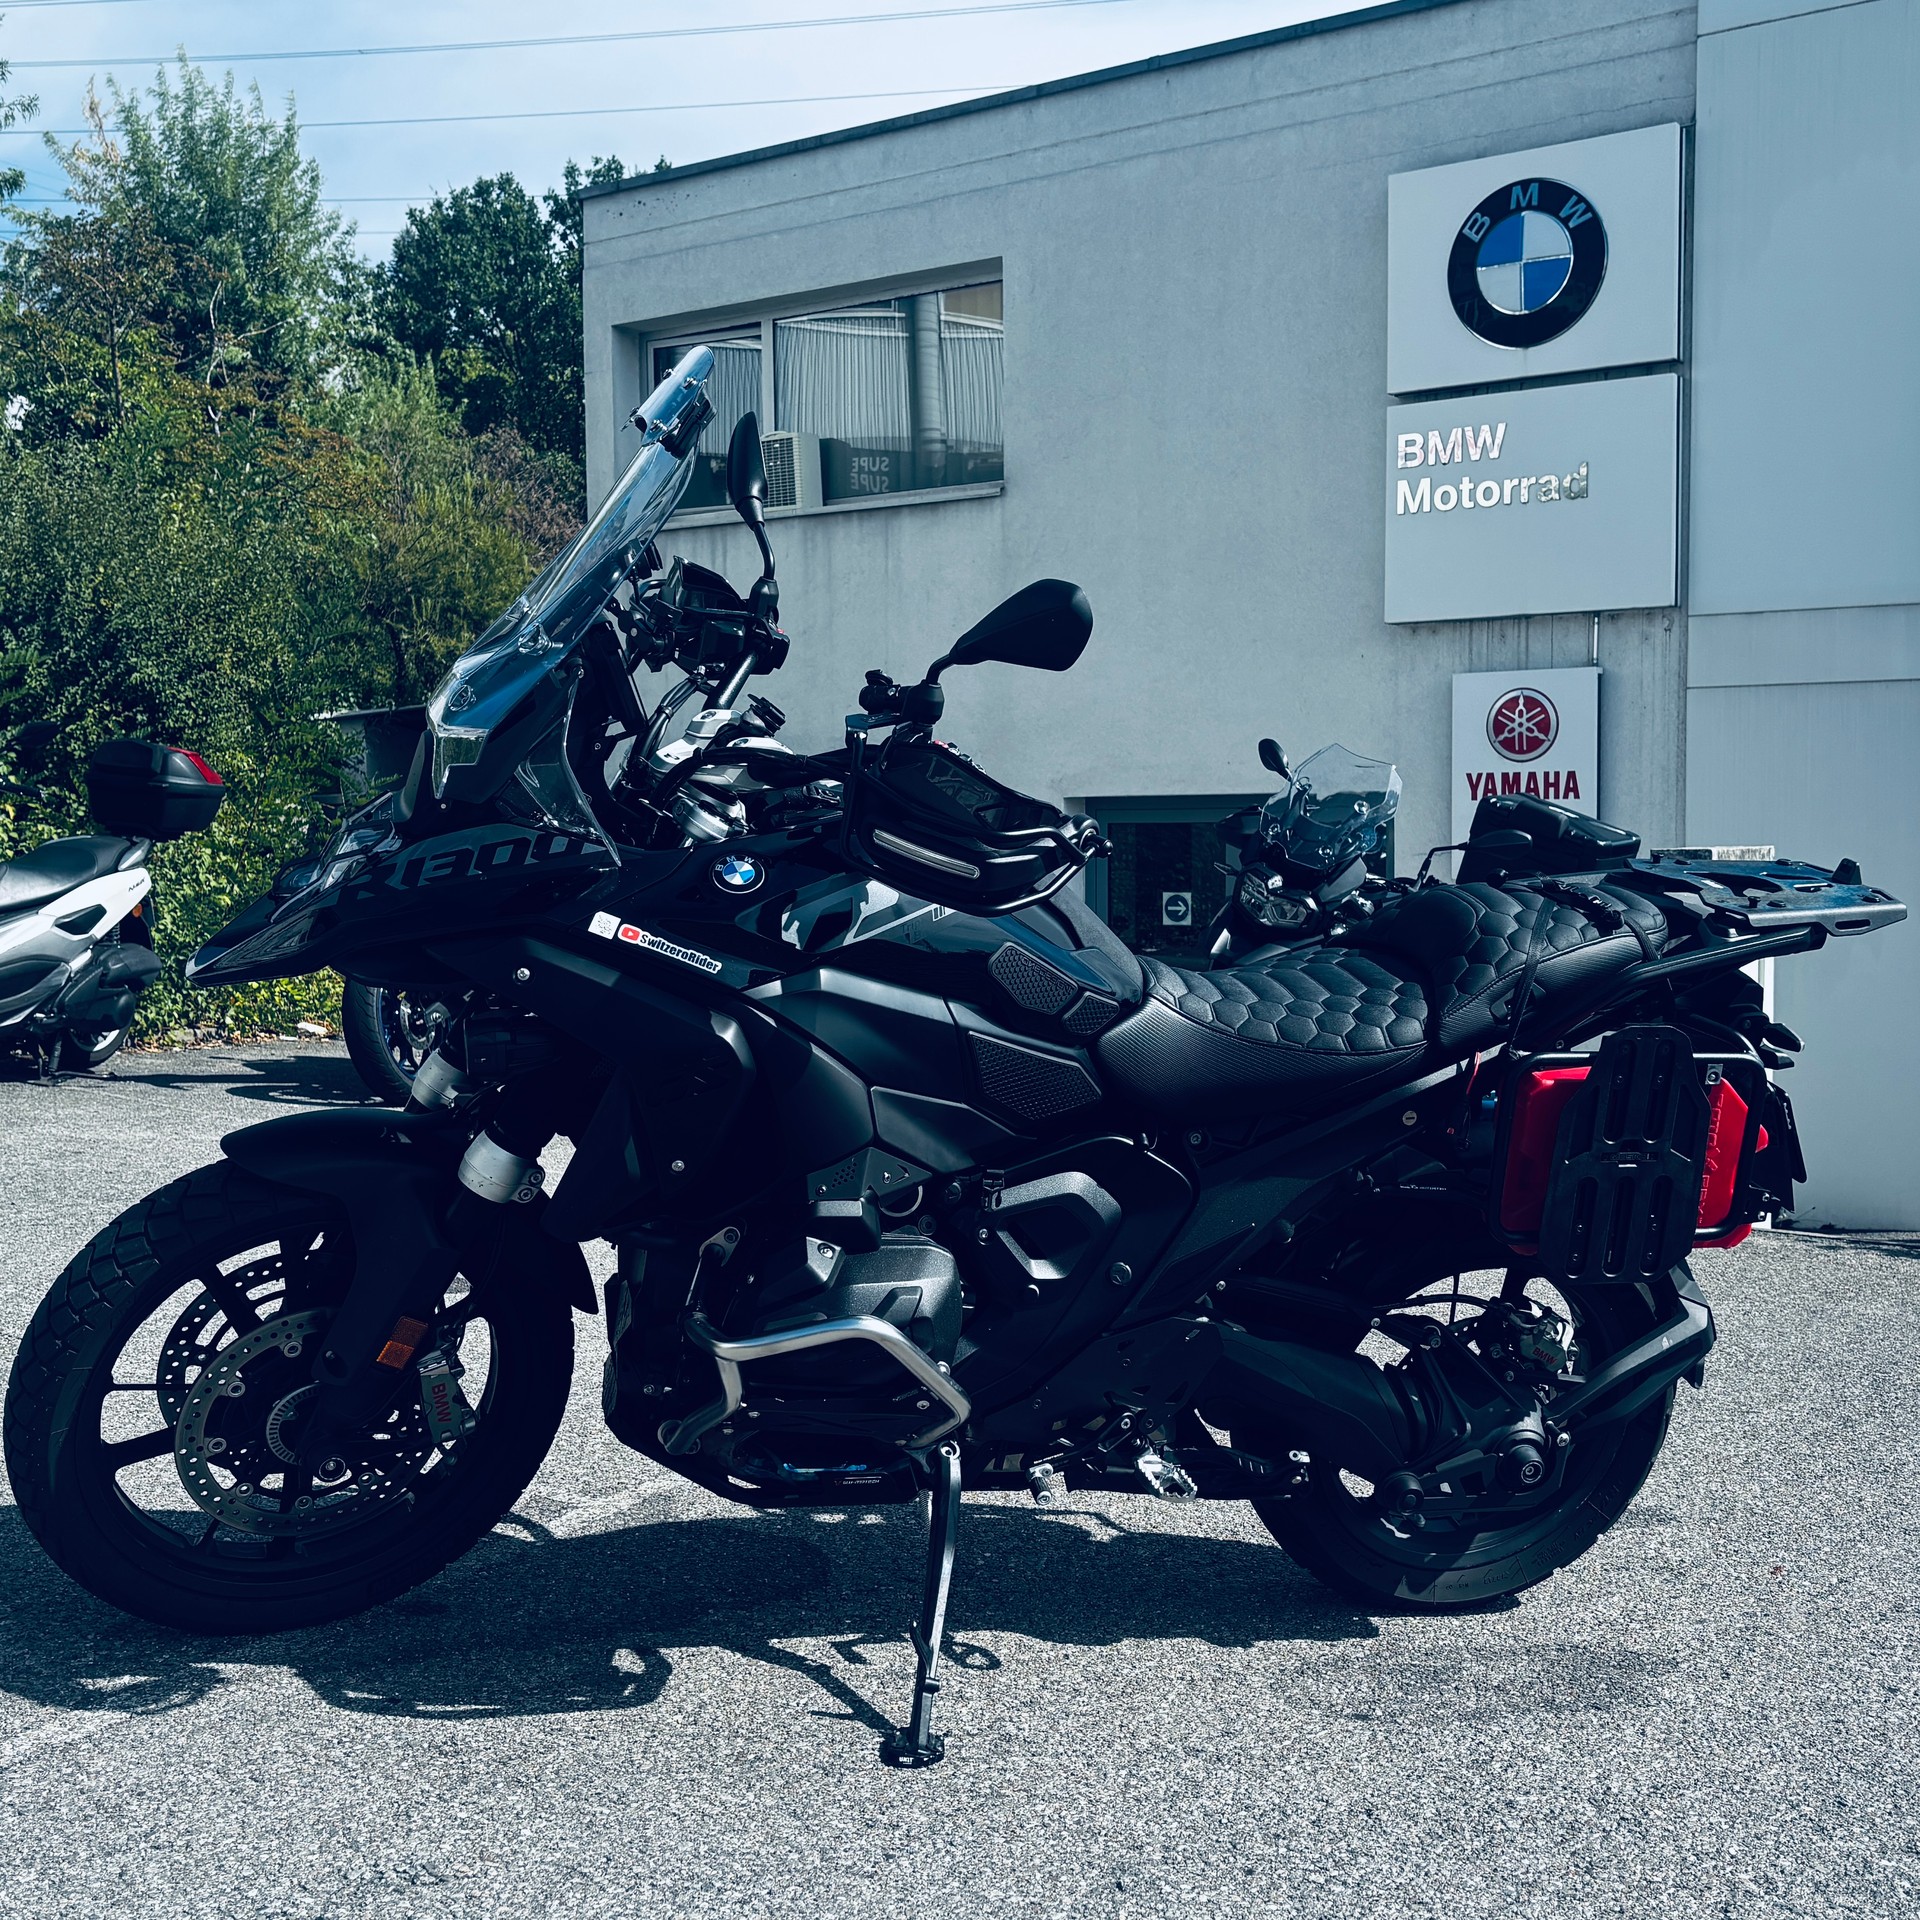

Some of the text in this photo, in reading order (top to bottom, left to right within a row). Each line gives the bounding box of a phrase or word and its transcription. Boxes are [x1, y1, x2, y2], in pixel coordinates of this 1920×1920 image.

[1462, 182, 1593, 243] BMW
[1397, 422, 1508, 469] BMW
[1395, 461, 1589, 516] Motorrad
[1465, 769, 1581, 801] YAMAHA
[714, 855, 755, 871] BMW
[639, 933, 720, 973] SwitzeroRider
[1532, 1346, 1558, 1366] BMW
[431, 1382, 452, 1423] BMW
